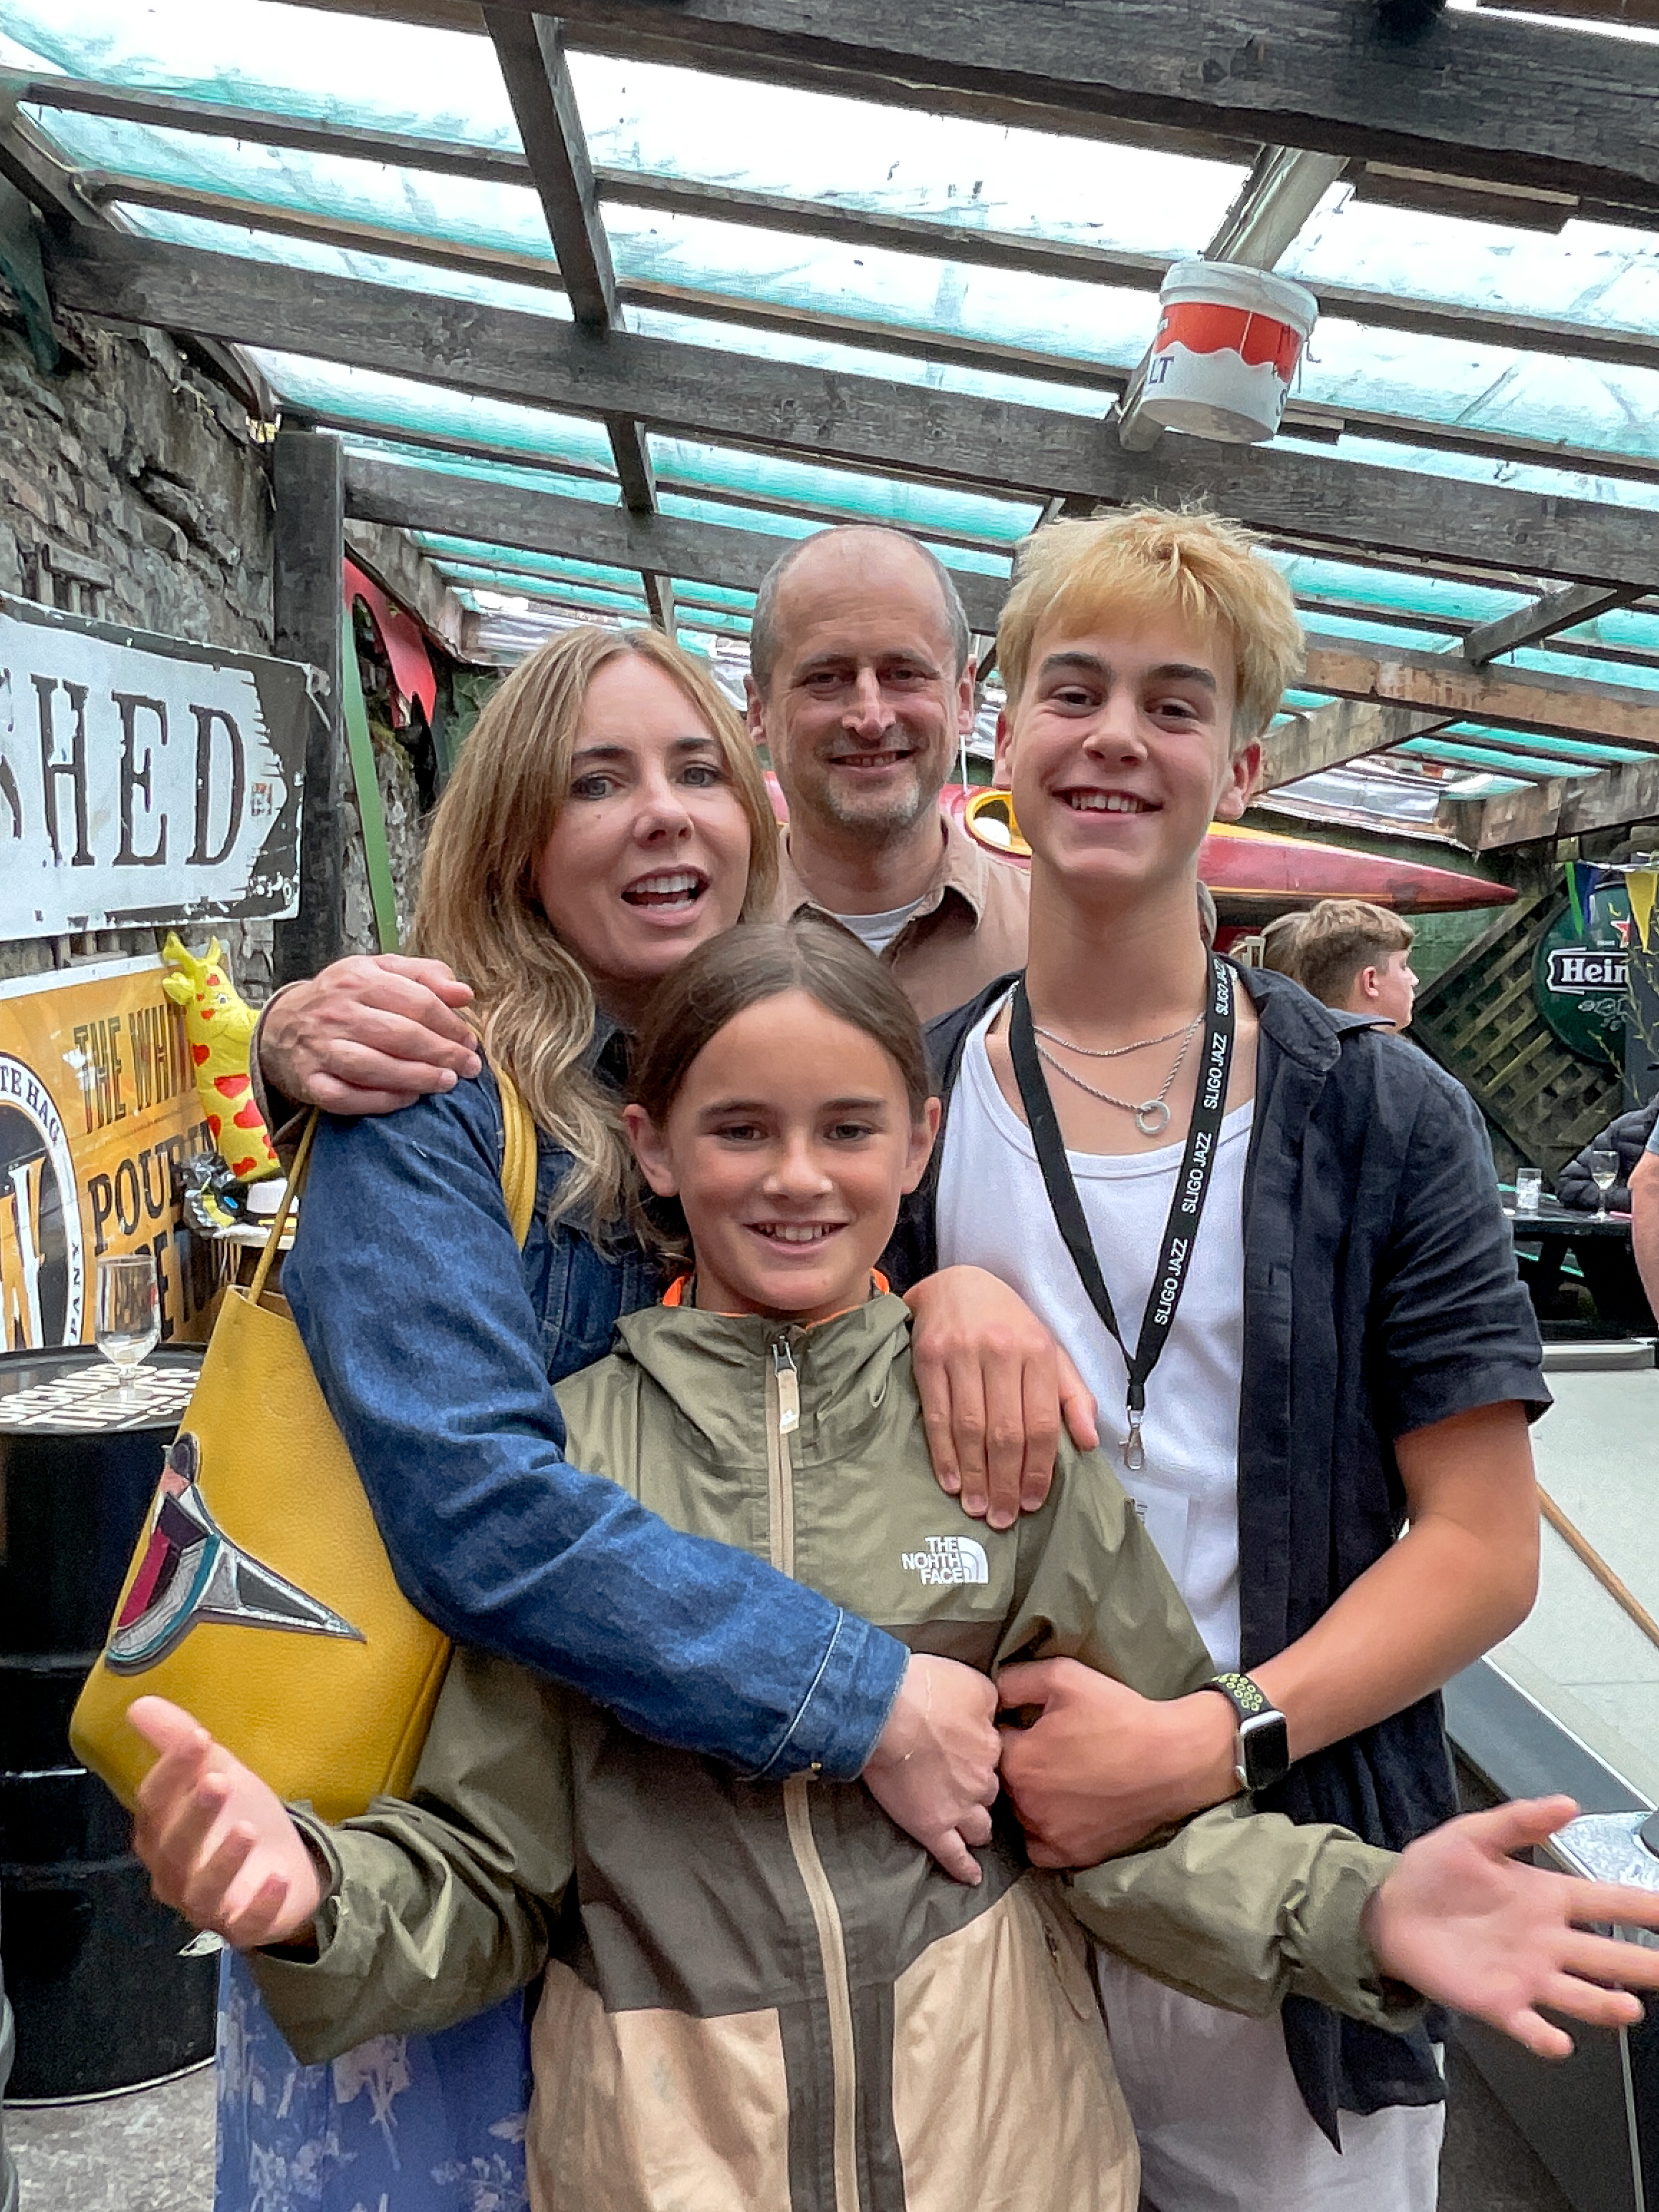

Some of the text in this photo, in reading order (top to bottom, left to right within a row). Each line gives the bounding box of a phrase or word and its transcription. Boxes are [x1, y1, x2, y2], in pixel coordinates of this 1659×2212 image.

[1216, 984, 1229, 1015] SLIGO
[74, 1016, 126, 1135] THE
[1204, 1032, 1228, 1110] SLIGO JAZZ
[1182, 1132, 1212, 1214] SLIGO JAZZ
[1155, 1238, 1188, 1325] SLIGO JAZZ
[901, 1552, 961, 1570] NORTH
[924, 1536, 958, 1553] THE
[920, 1567, 964, 1585] FACE
